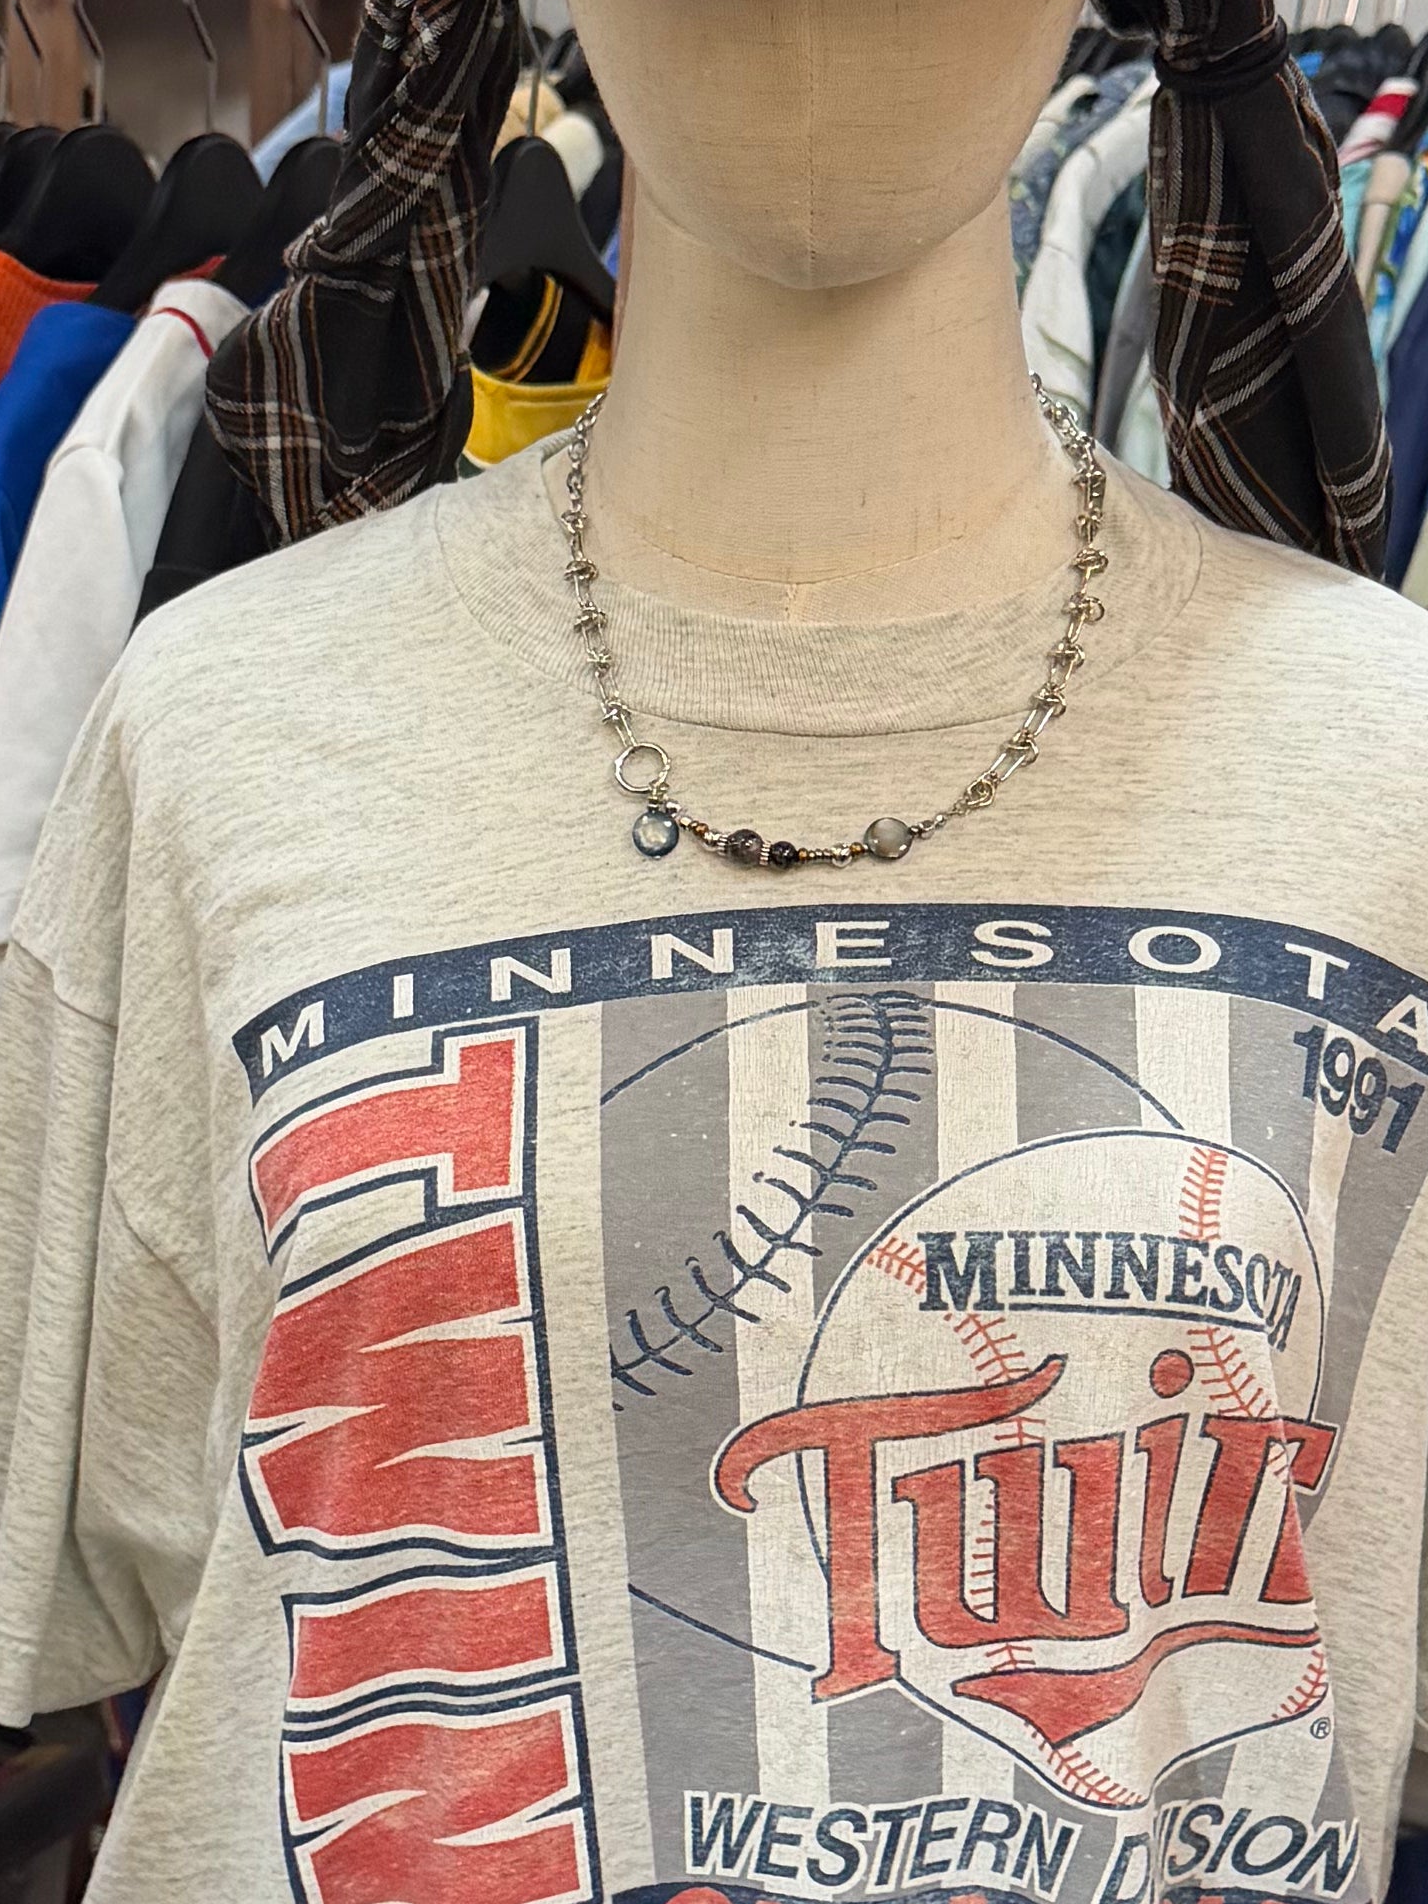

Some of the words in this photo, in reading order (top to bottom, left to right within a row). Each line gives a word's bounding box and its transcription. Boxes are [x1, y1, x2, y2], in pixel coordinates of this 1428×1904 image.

[1293, 1024, 1427, 1154] 1991
[916, 1230, 1303, 1352] MINNESOTA
[714, 1352, 1339, 1704] Twin
[684, 1793, 1080, 1901] WESTERN
